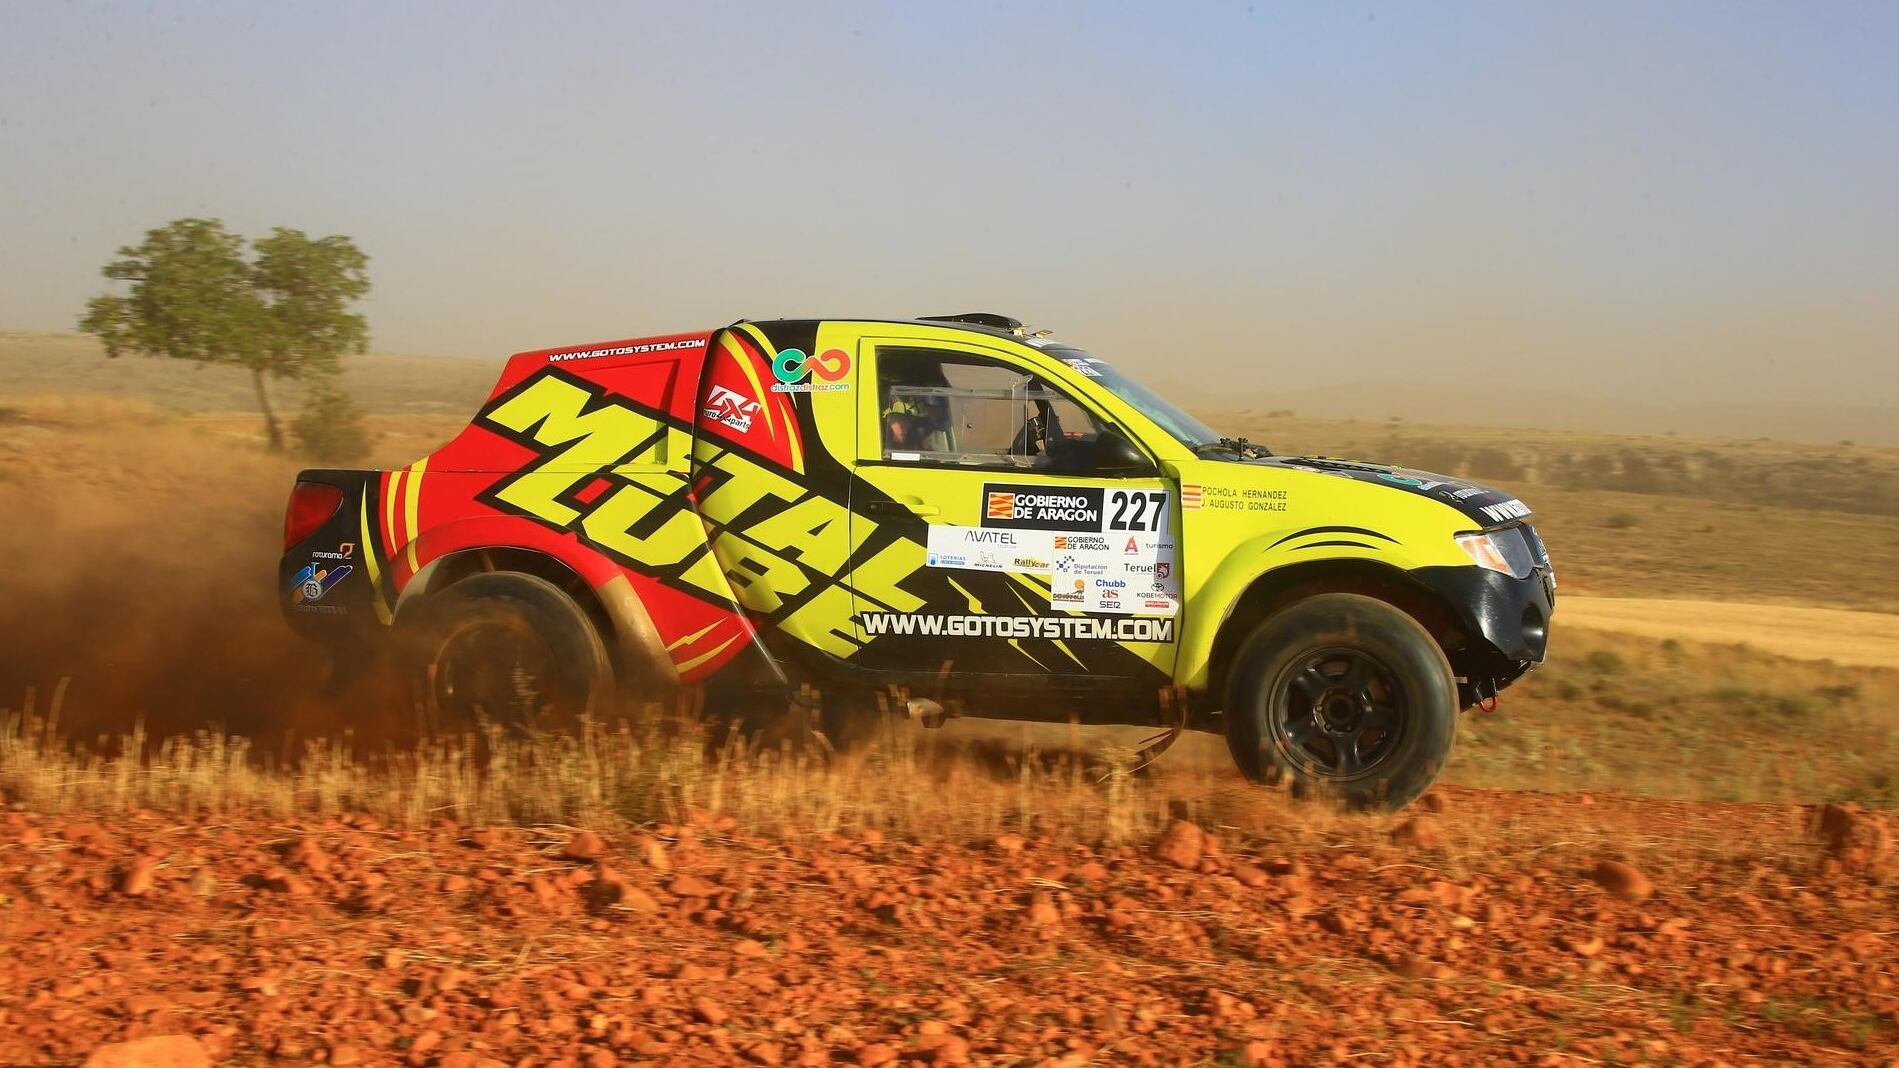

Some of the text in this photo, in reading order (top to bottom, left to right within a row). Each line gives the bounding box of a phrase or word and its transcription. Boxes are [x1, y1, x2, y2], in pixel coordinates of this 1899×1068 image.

[549, 339, 706, 362] WWW.GOTOSYSTEM.COM
[486, 374, 928, 613] METAL
[1202, 486, 1287, 499] POCHOLA HERNANDEZ
[1015, 494, 1088, 509] GOBIERNO
[1210, 500, 1244, 509] AUGUSTO
[1248, 502, 1287, 511] GONZALEZ
[1014, 507, 1098, 522] DE ARAGON
[1109, 491, 1167, 532] 227
[965, 530, 1017, 545] AVATEL
[1068, 536, 1105, 544] GOBIERNO
[495, 472, 894, 660] LUBE
[1124, 563, 1156, 573] Teruel
[1095, 579, 1126, 588] Chubb
[1102, 588, 1119, 599] as
[1136, 592, 1178, 600] KOBEMOTOR
[1099, 600, 1121, 609] SER
[863, 613, 1174, 641] WWW.GOTOSYSTEM.COM
